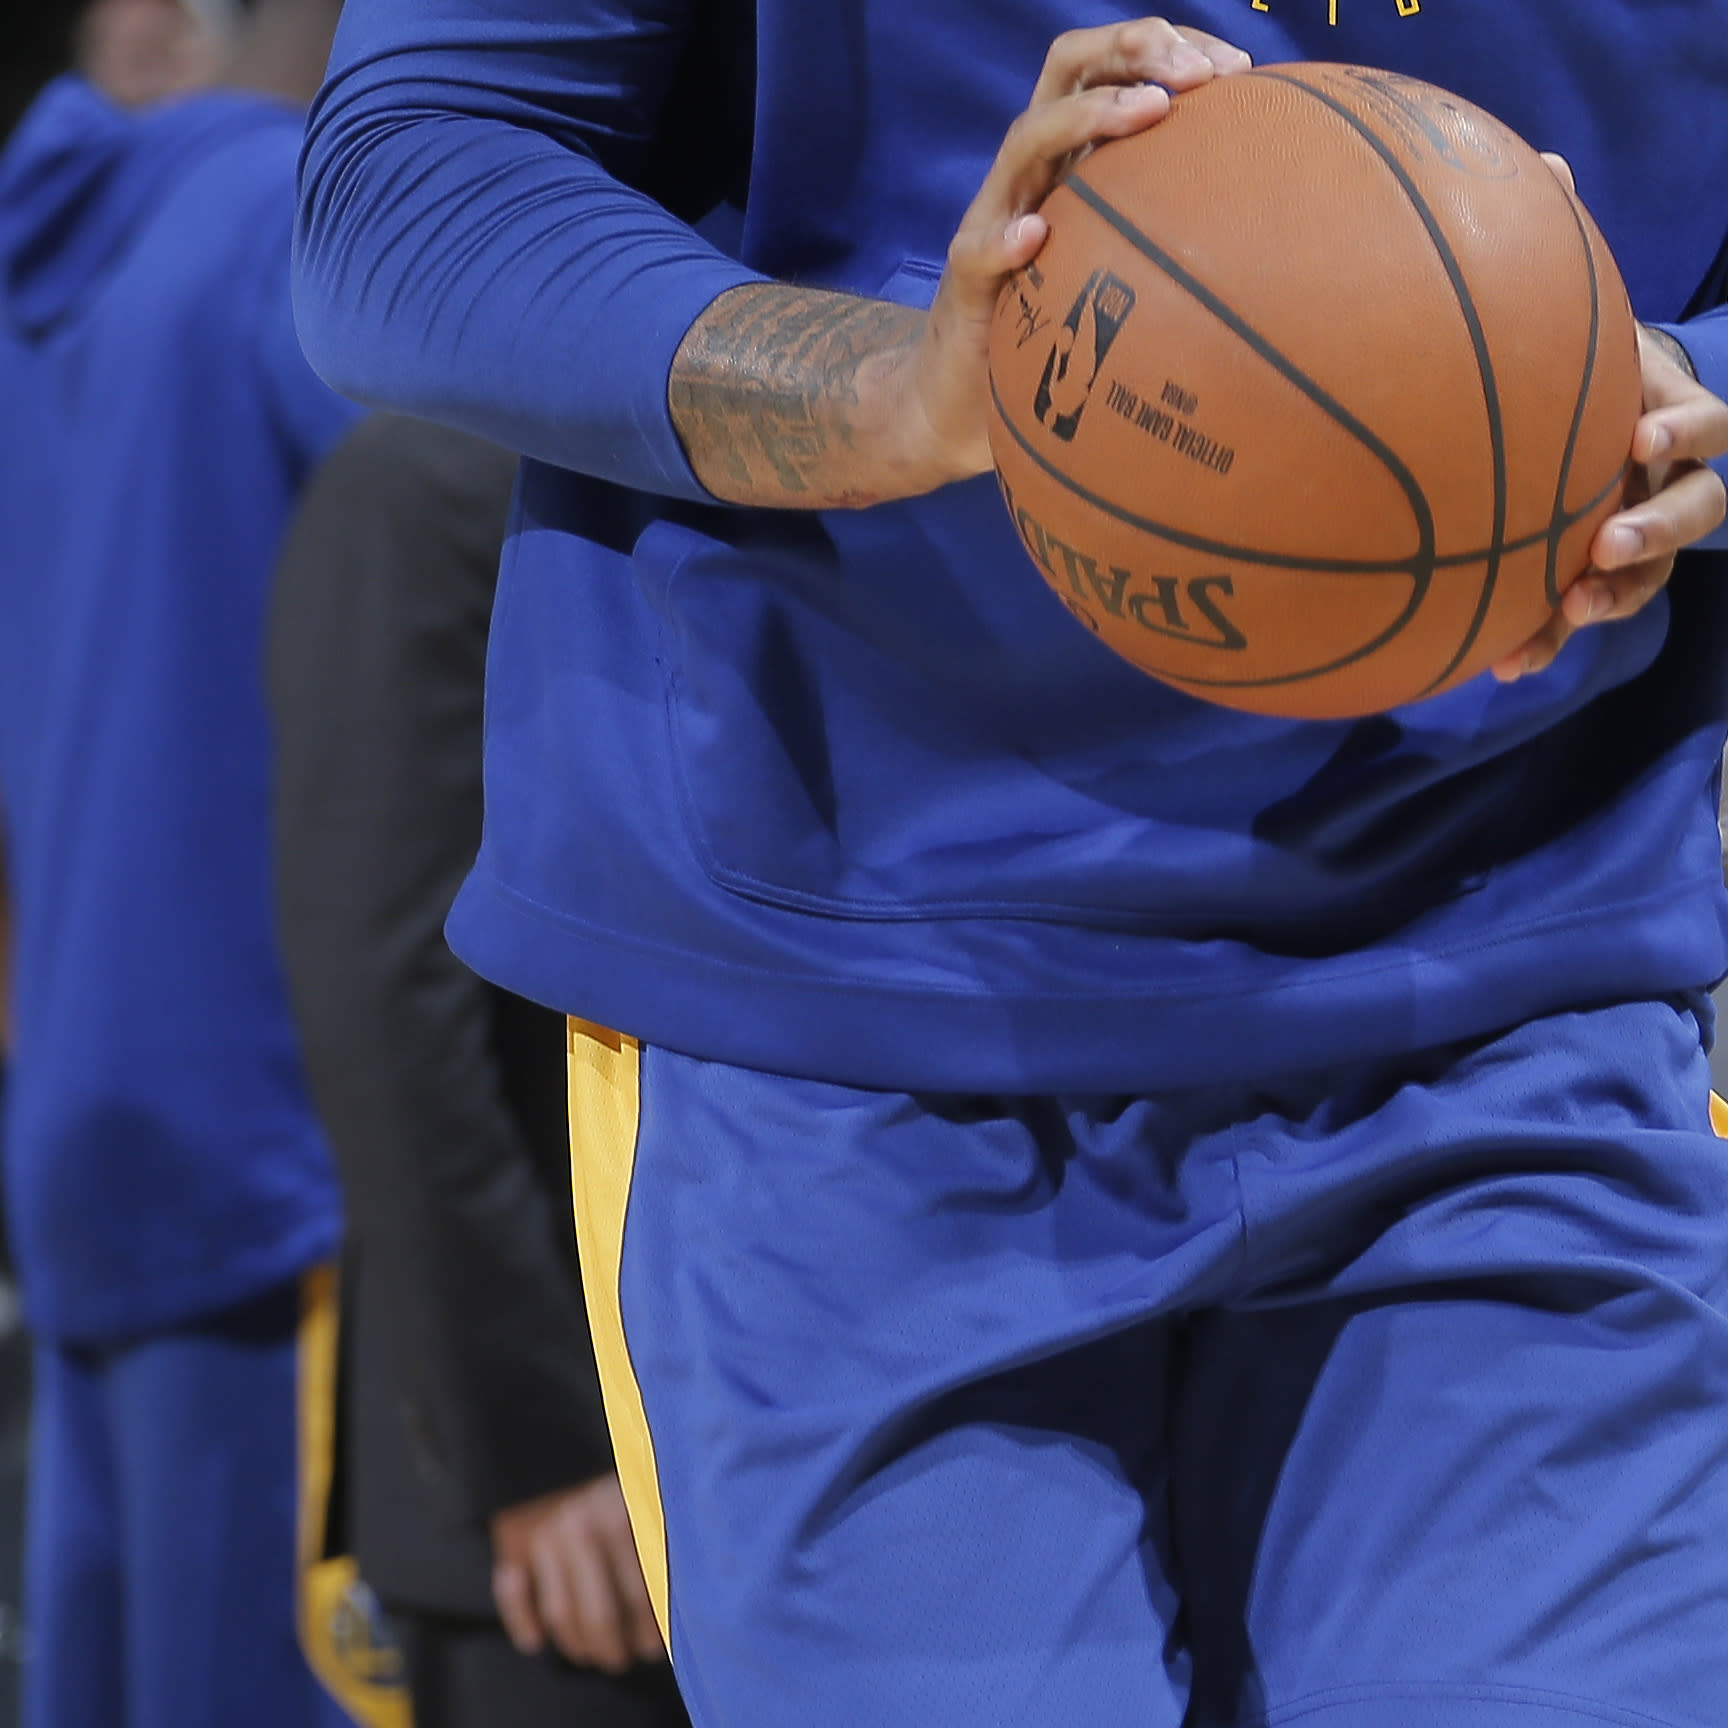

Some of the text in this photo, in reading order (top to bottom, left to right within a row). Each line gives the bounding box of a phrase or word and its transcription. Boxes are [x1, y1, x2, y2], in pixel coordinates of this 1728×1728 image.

[1106, 378, 1235, 475] OFFICIAL GAME BALL
[1008, 492, 1247, 650] SPALD
